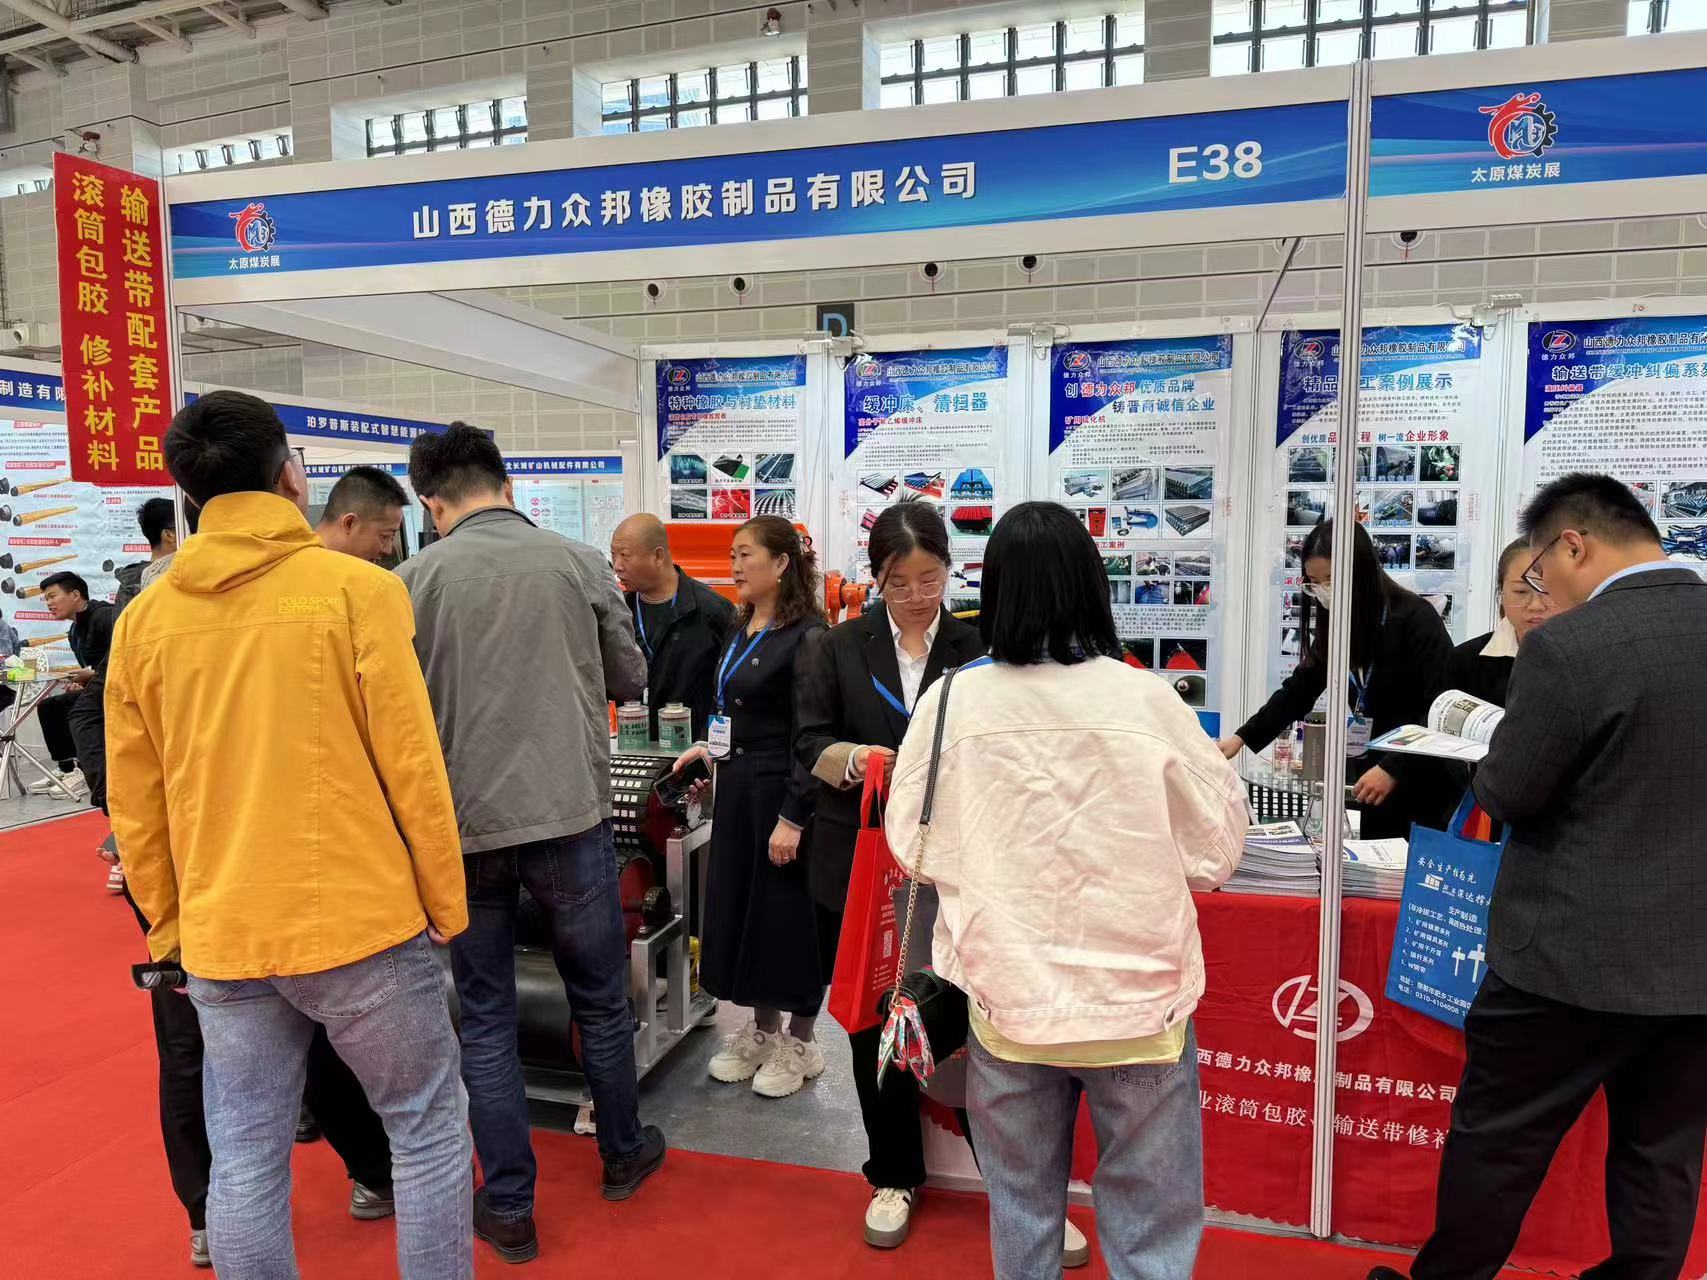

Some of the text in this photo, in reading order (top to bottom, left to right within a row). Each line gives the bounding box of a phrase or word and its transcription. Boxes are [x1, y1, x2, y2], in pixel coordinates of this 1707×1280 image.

[1168, 140, 1263, 184] E38
[1471, 162, 1561, 184] 太原煤炭展
[412, 161, 977, 240] 山西德力众邦橡胶制品有限公司
[72, 170, 110, 315] 滚筒包胶
[228, 255, 280, 271] 太原煤炭展
[120, 184, 164, 471] 输送带配套产品
[823, 312, 848, 337] D
[80, 333, 119, 472] 修补材料
[1303, 373, 1454, 393] 精品工案例展示
[1111, 397, 1215, 415] 铸晋商诚信企业
[1197, 1048, 1457, 1104] 西德力众邦橡制品有限公司
